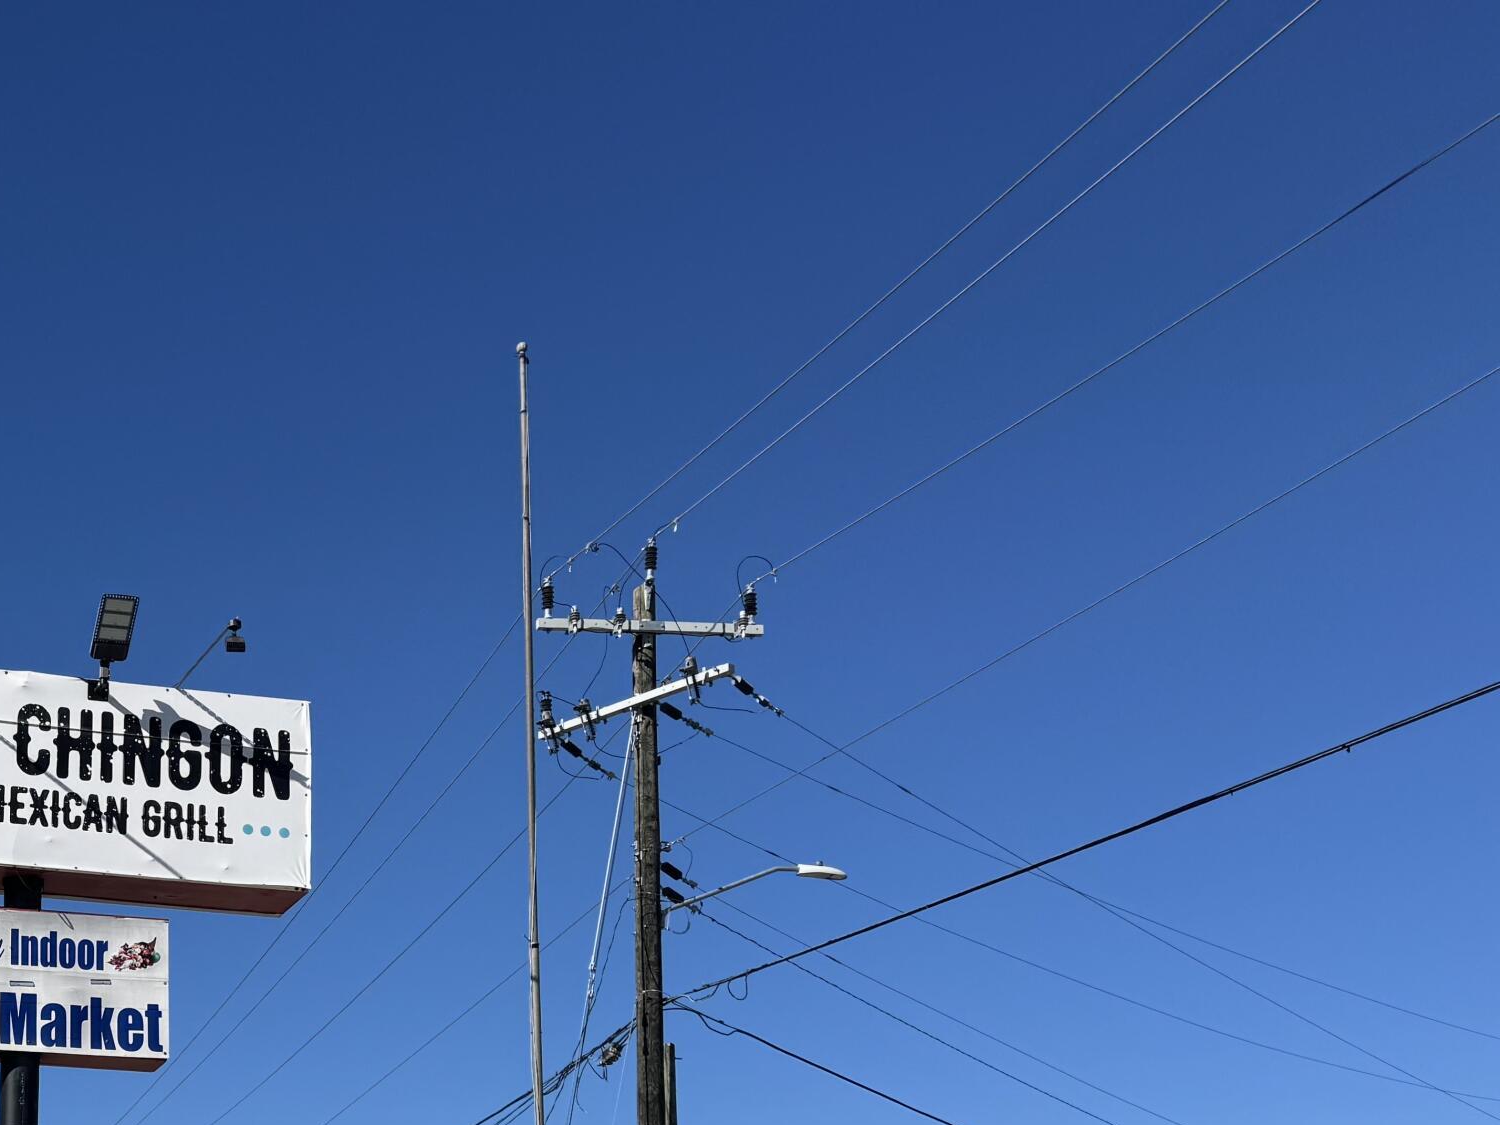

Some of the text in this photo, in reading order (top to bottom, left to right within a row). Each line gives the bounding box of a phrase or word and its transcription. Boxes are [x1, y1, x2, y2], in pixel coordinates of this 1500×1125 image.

[13, 703, 293, 800] CHINGON
[141, 799, 233, 844] GRILL
[10, 928, 109, 970] Indoor
[0, 991, 164, 1053] Market
